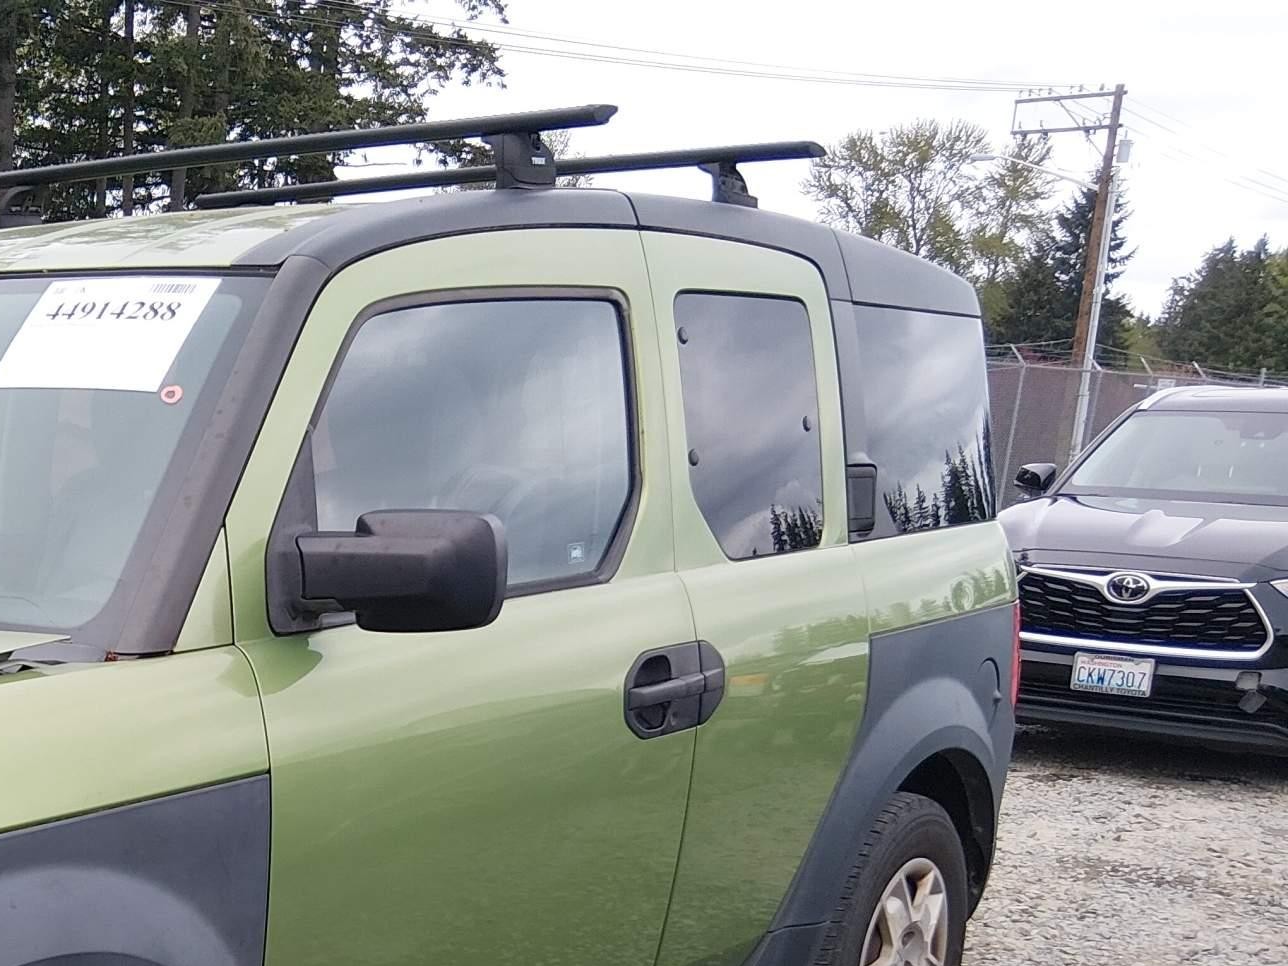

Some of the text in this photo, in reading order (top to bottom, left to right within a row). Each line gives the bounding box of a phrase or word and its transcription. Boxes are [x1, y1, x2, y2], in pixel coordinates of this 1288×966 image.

[45, 301, 182, 320] 44914288
[1080, 660, 1122, 668] WASHINGTON
[1077, 665, 1147, 689] CKW7307
[1073, 683, 1146, 696] CHANTILLY TOYOTA
